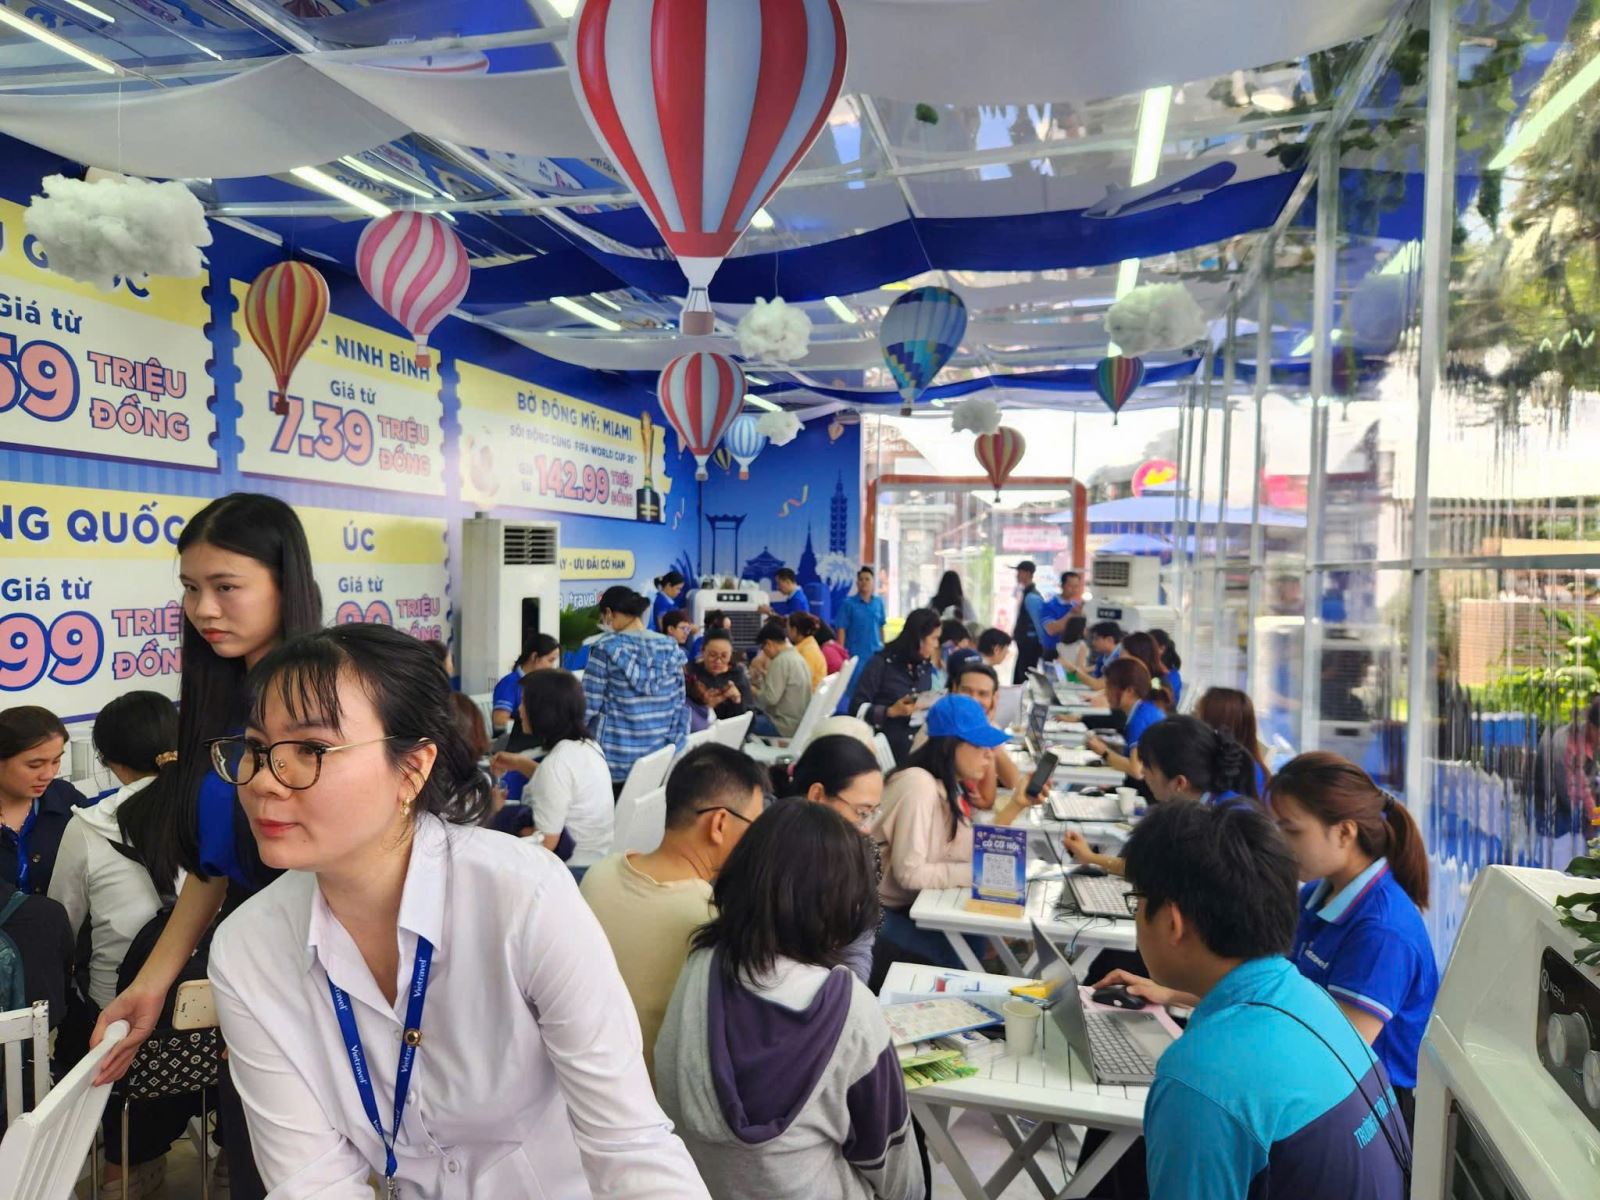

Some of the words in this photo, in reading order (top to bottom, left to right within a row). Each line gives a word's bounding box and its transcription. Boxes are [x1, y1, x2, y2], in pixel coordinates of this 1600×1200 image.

[51, 307, 83, 334] từ
[335, 335, 384, 368] NINH
[87, 350, 187, 402] TRIỆU
[330, 380, 355, 400] Giá
[360, 386, 377, 405] từ
[89, 393, 190, 442] ĐỒNG
[268, 390, 374, 467] 7.39
[377, 414, 430, 449] TRIỆU
[517, 390, 537, 414] BỜ
[541, 398, 578, 426] ĐÔNG
[603, 419, 632, 441] MIAMI
[379, 443, 431, 477] ĐỒNG
[591, 445, 614, 460] WORLD
[615, 451, 627, 462] CUP
[534, 453, 610, 505] 142.99
[67, 501, 186, 545] QUỐC
[342, 520, 375, 551] ÚC
[1, 577, 51, 601] Giá
[61, 577, 93, 600] từ
[338, 576, 363, 593] Giá
[367, 576, 384, 592] từ
[111, 600, 185, 641] TRIỆ
[396, 593, 440, 621] TRIỆU
[112, 638, 183, 681] ĐỒN
